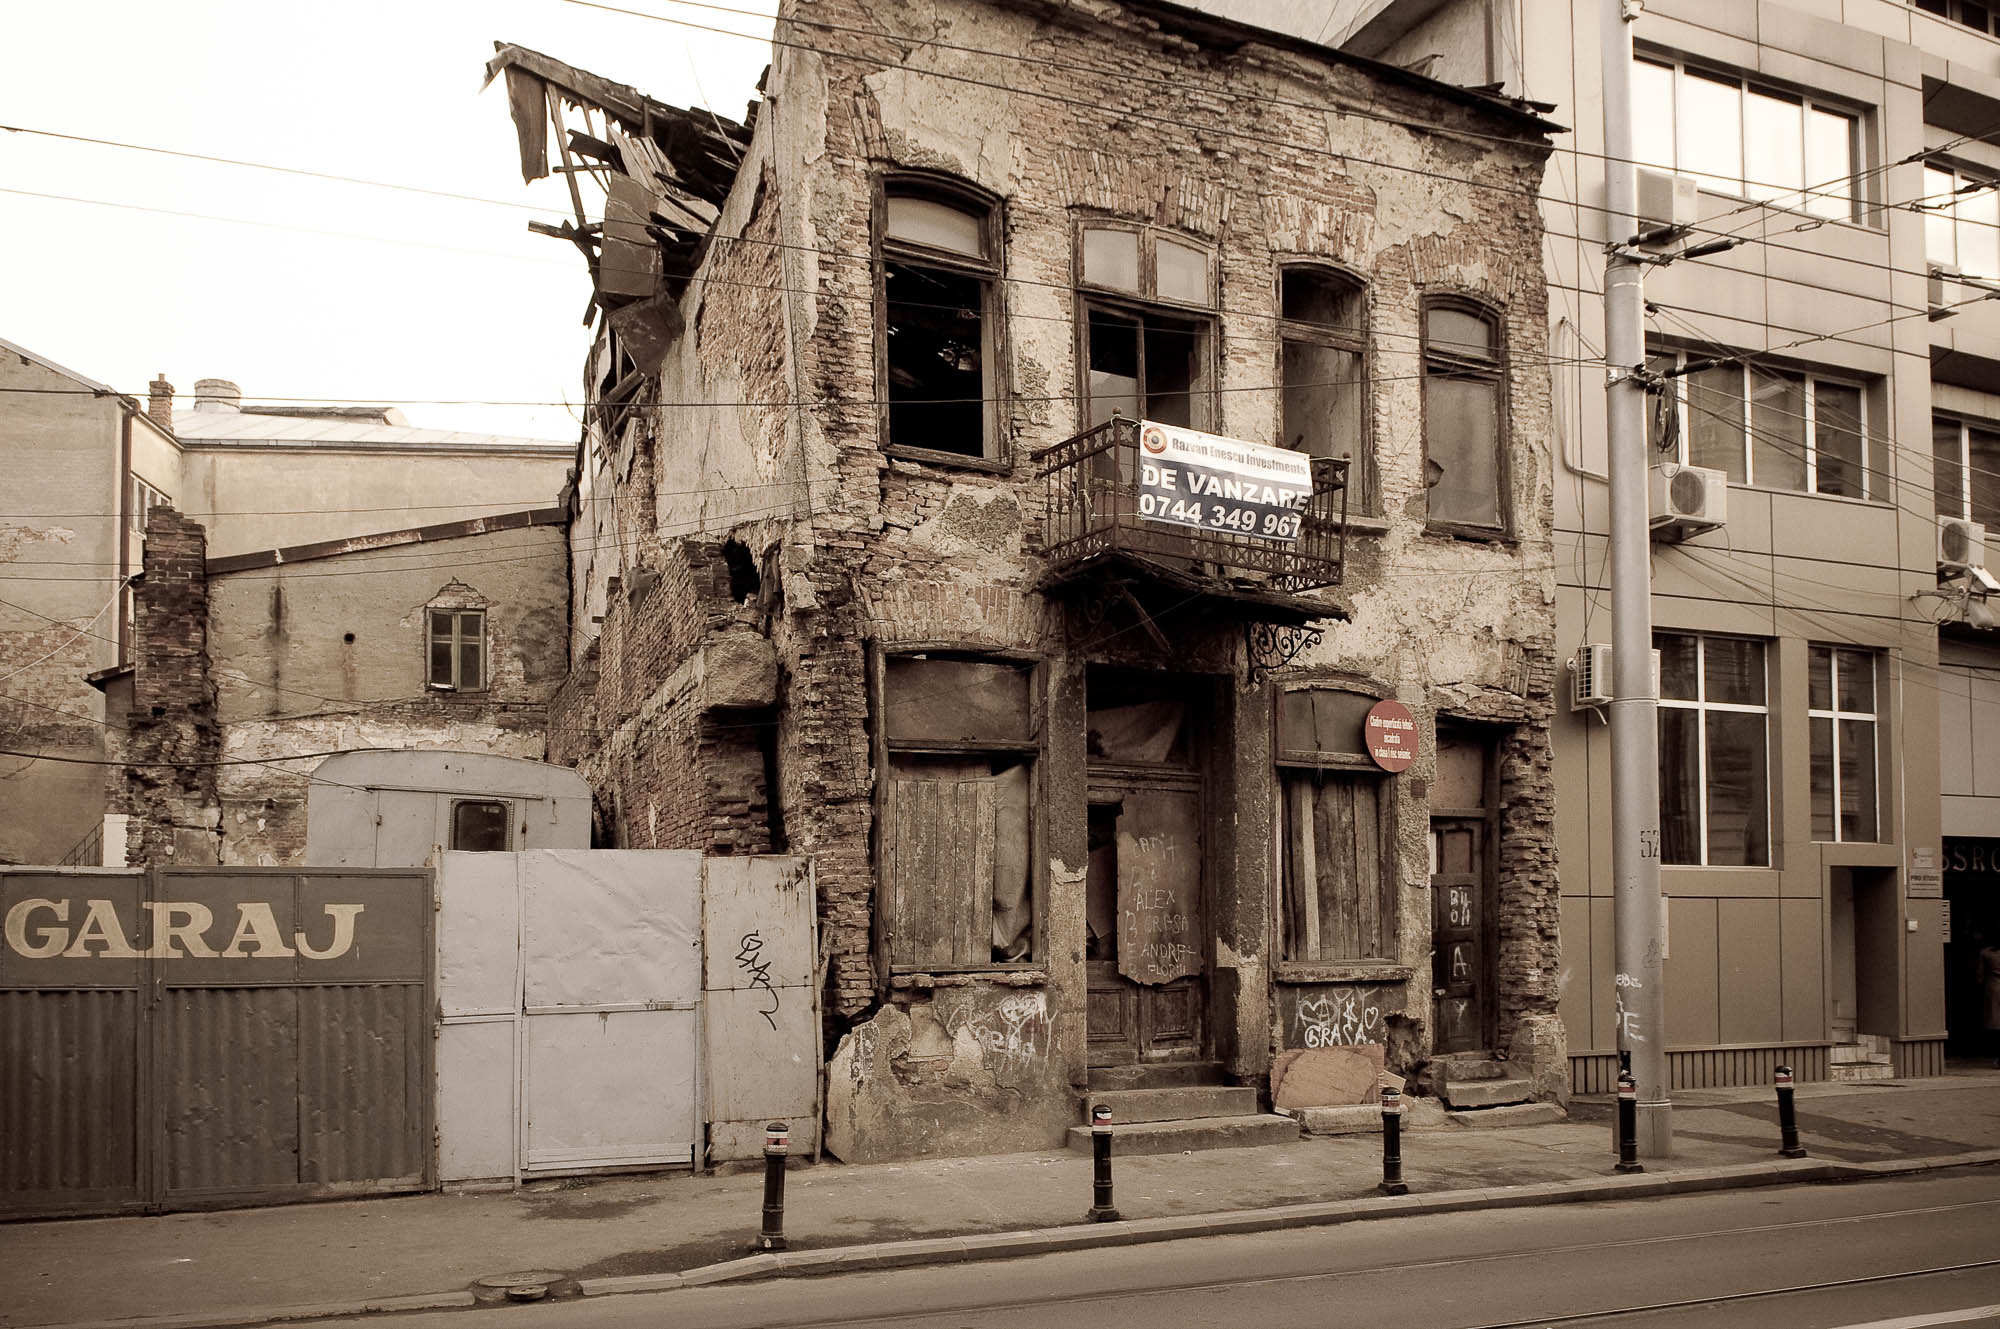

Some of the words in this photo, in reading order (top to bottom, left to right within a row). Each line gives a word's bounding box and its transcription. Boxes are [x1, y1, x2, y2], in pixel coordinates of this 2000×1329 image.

[1172, 438, 1208, 456] Razvan
[1209, 444, 1245, 464] Enescu
[1246, 453, 1307, 475] Investments
[1141, 464, 1177, 491] DE
[1187, 471, 1312, 512] VANZARE
[1140, 493, 1202, 524] 0744
[1210, 505, 1257, 532] 349
[1263, 513, 1302, 538] 967
[1135, 890, 1176, 911] ALEX
[4, 898, 364, 960] GARAJ
